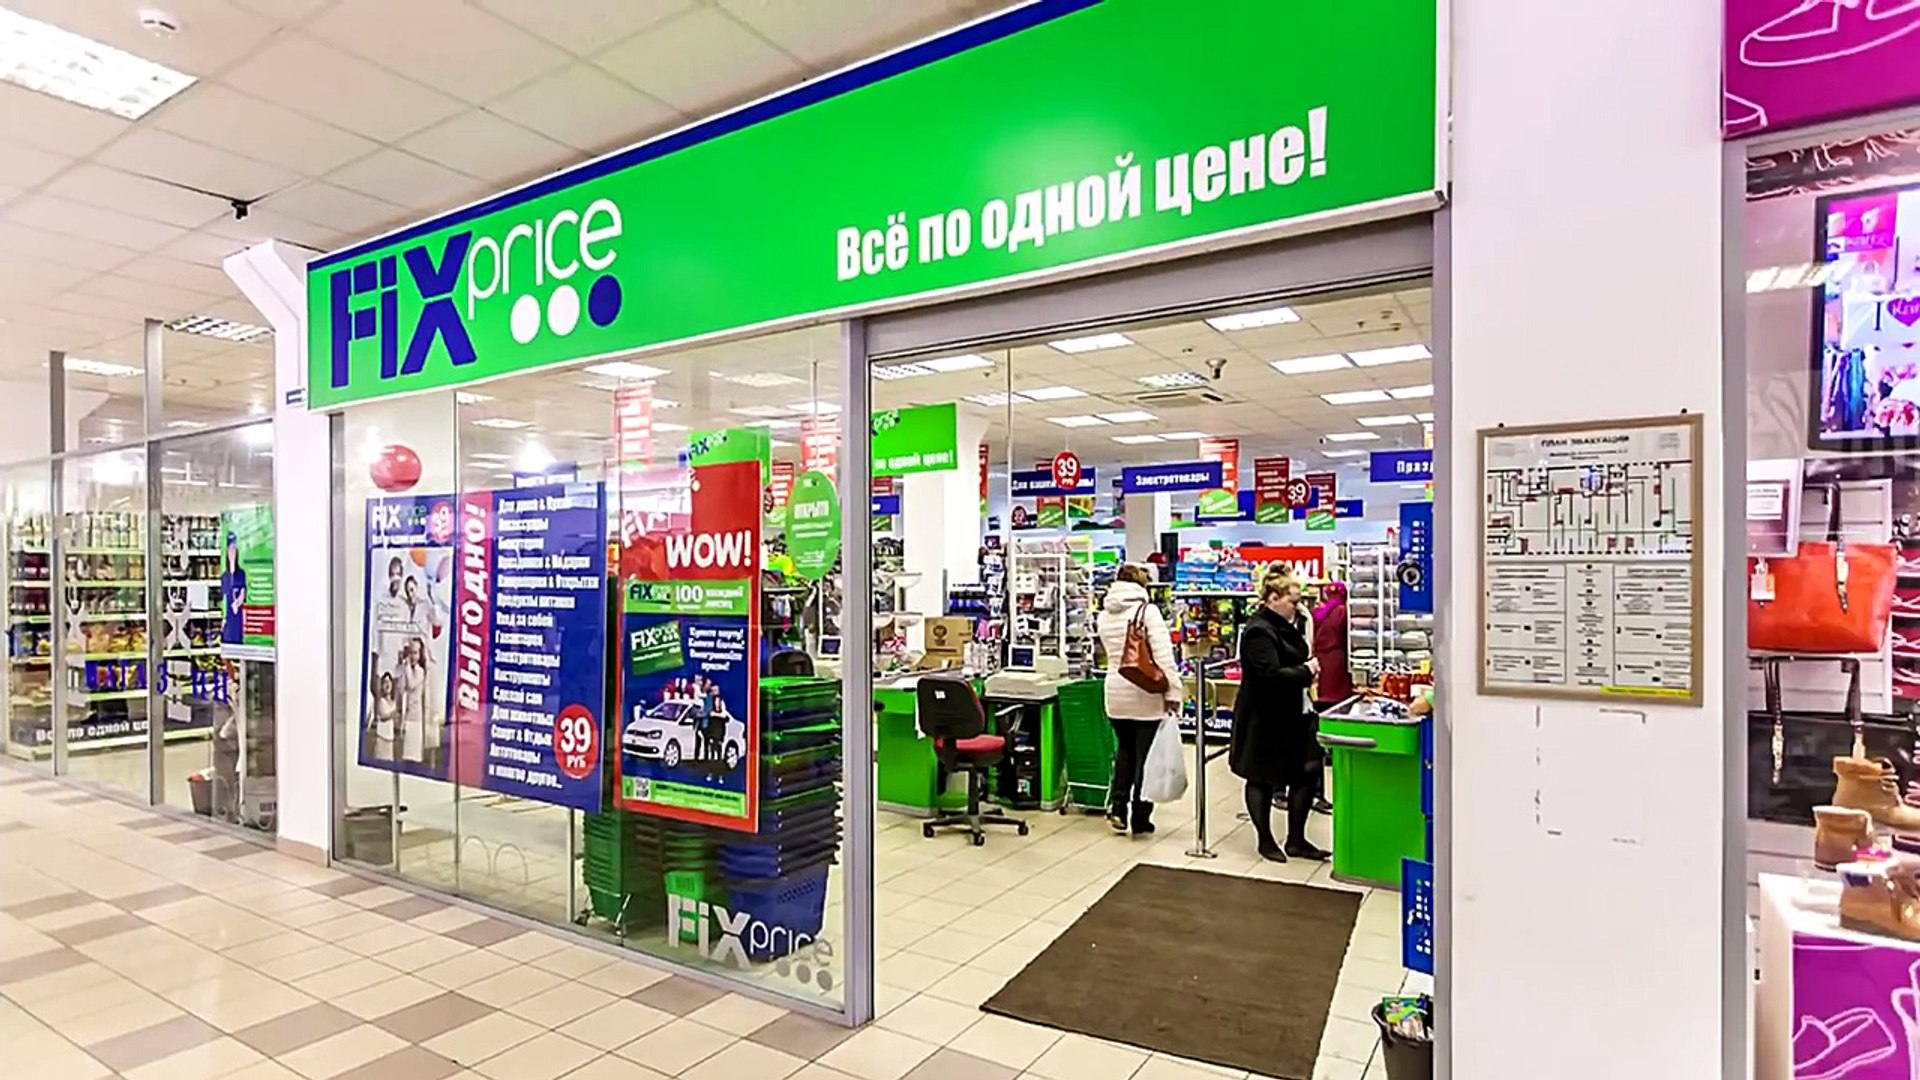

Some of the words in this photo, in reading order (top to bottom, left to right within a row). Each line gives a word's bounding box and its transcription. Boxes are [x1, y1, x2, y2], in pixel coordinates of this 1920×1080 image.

[836, 212, 909, 282] Всё
[918, 207, 971, 264] по
[980, 152, 1142, 253] одной
[1154, 105, 1328, 216] цене!
[468, 198, 622, 320] price
[1057, 457, 1077, 477] 39
[1135, 472, 1210, 486] Электротовары
[1287, 484, 1307, 501] 39
[666, 529, 751, 568] WOW!
[458, 502, 488, 711] ВЫГОДНО!
[675, 585, 704, 602] 100
[560, 717, 592, 753] 39
[566, 755, 587, 768] РУБ
